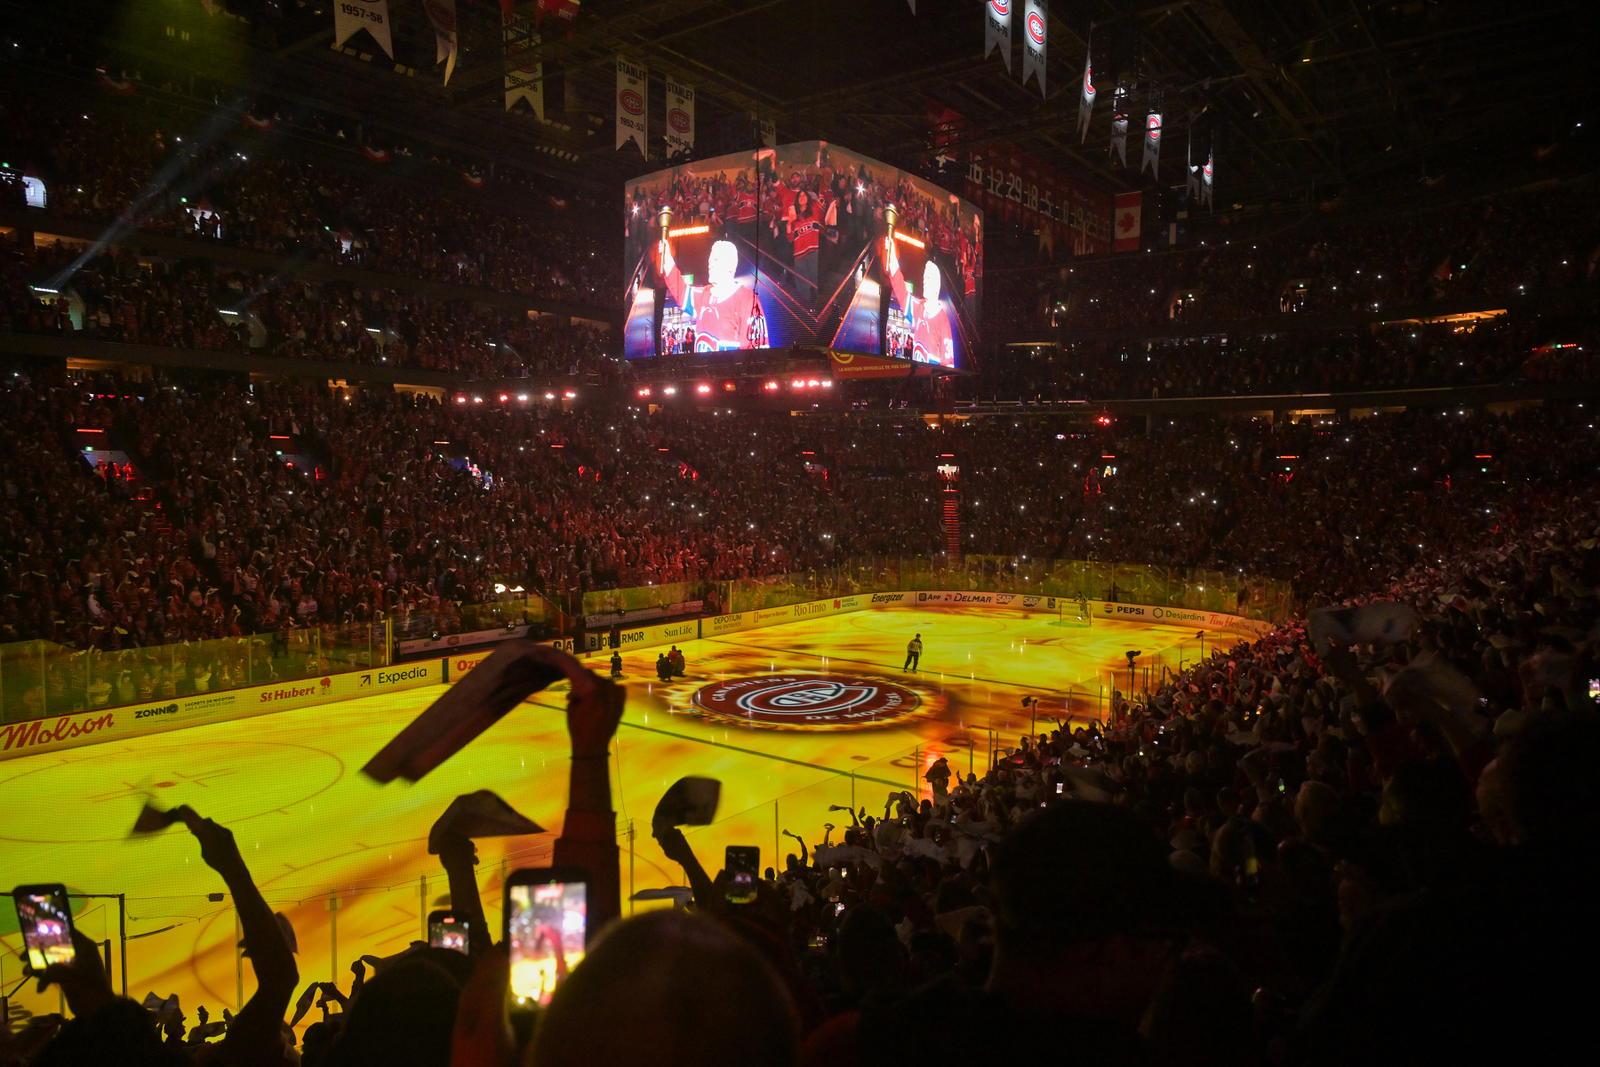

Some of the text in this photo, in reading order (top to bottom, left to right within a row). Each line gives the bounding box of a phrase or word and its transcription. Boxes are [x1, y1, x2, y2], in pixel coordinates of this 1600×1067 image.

[341, 3, 383, 24] 1957-58
[871, 593, 904, 603] Energizer
[953, 593, 992, 603] DELMAR
[1117, 606, 1144, 615] PEPSI
[1165, 610, 1206, 622] Desjardins
[664, 626, 693, 638] Sun Life
[378, 666, 428, 684] Expedia
[0, 713, 114, 751] Molson
